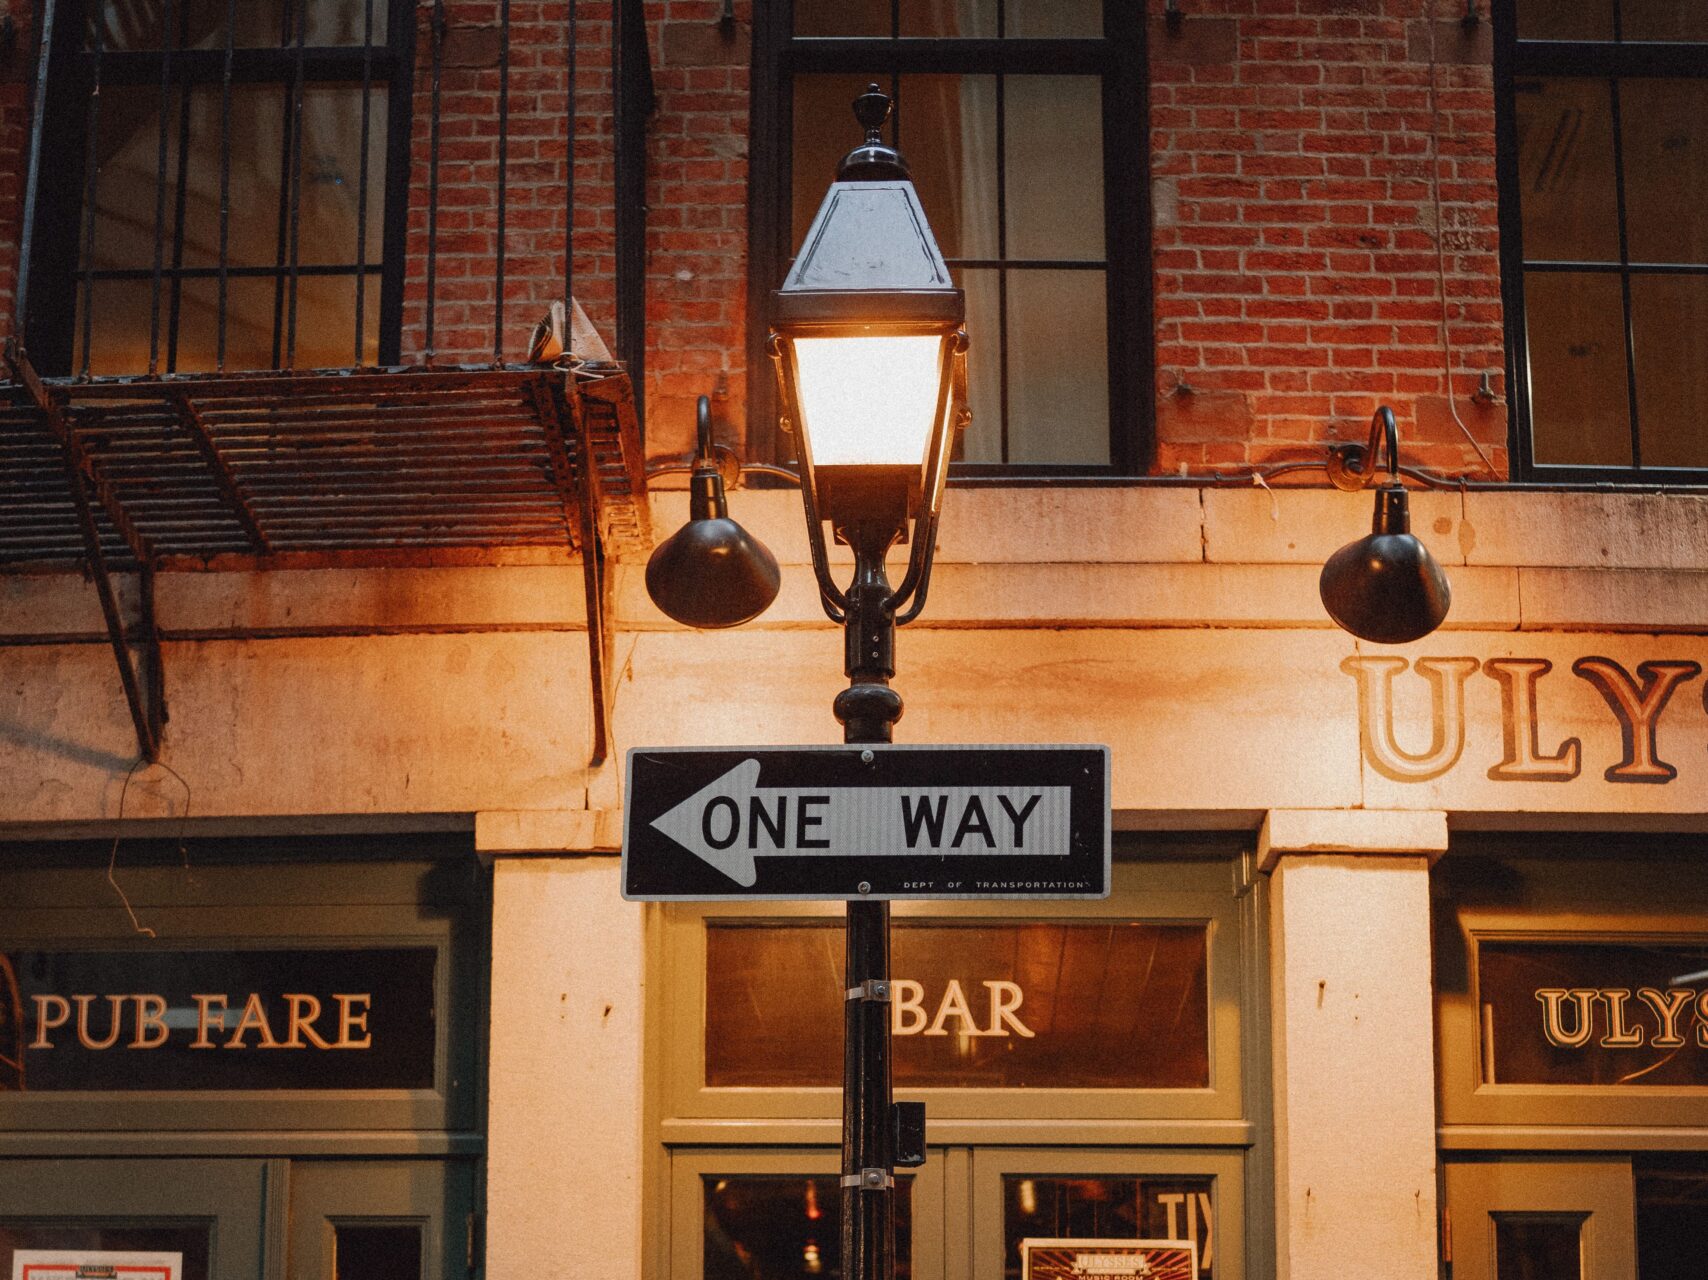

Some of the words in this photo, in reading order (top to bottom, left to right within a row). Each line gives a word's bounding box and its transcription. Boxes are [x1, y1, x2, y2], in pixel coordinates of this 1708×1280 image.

[1340, 655, 1708, 784] ULY
[701, 794, 830, 850] ONE
[901, 794, 1042, 848] WAY
[903, 881, 934, 889] DEPT
[947, 881, 963, 889] OF
[976, 881, 1084, 889] TRANSPORTATION
[29, 993, 170, 1050] PUB
[189, 993, 372, 1050] FARE
[891, 979, 1036, 1038] BAR
